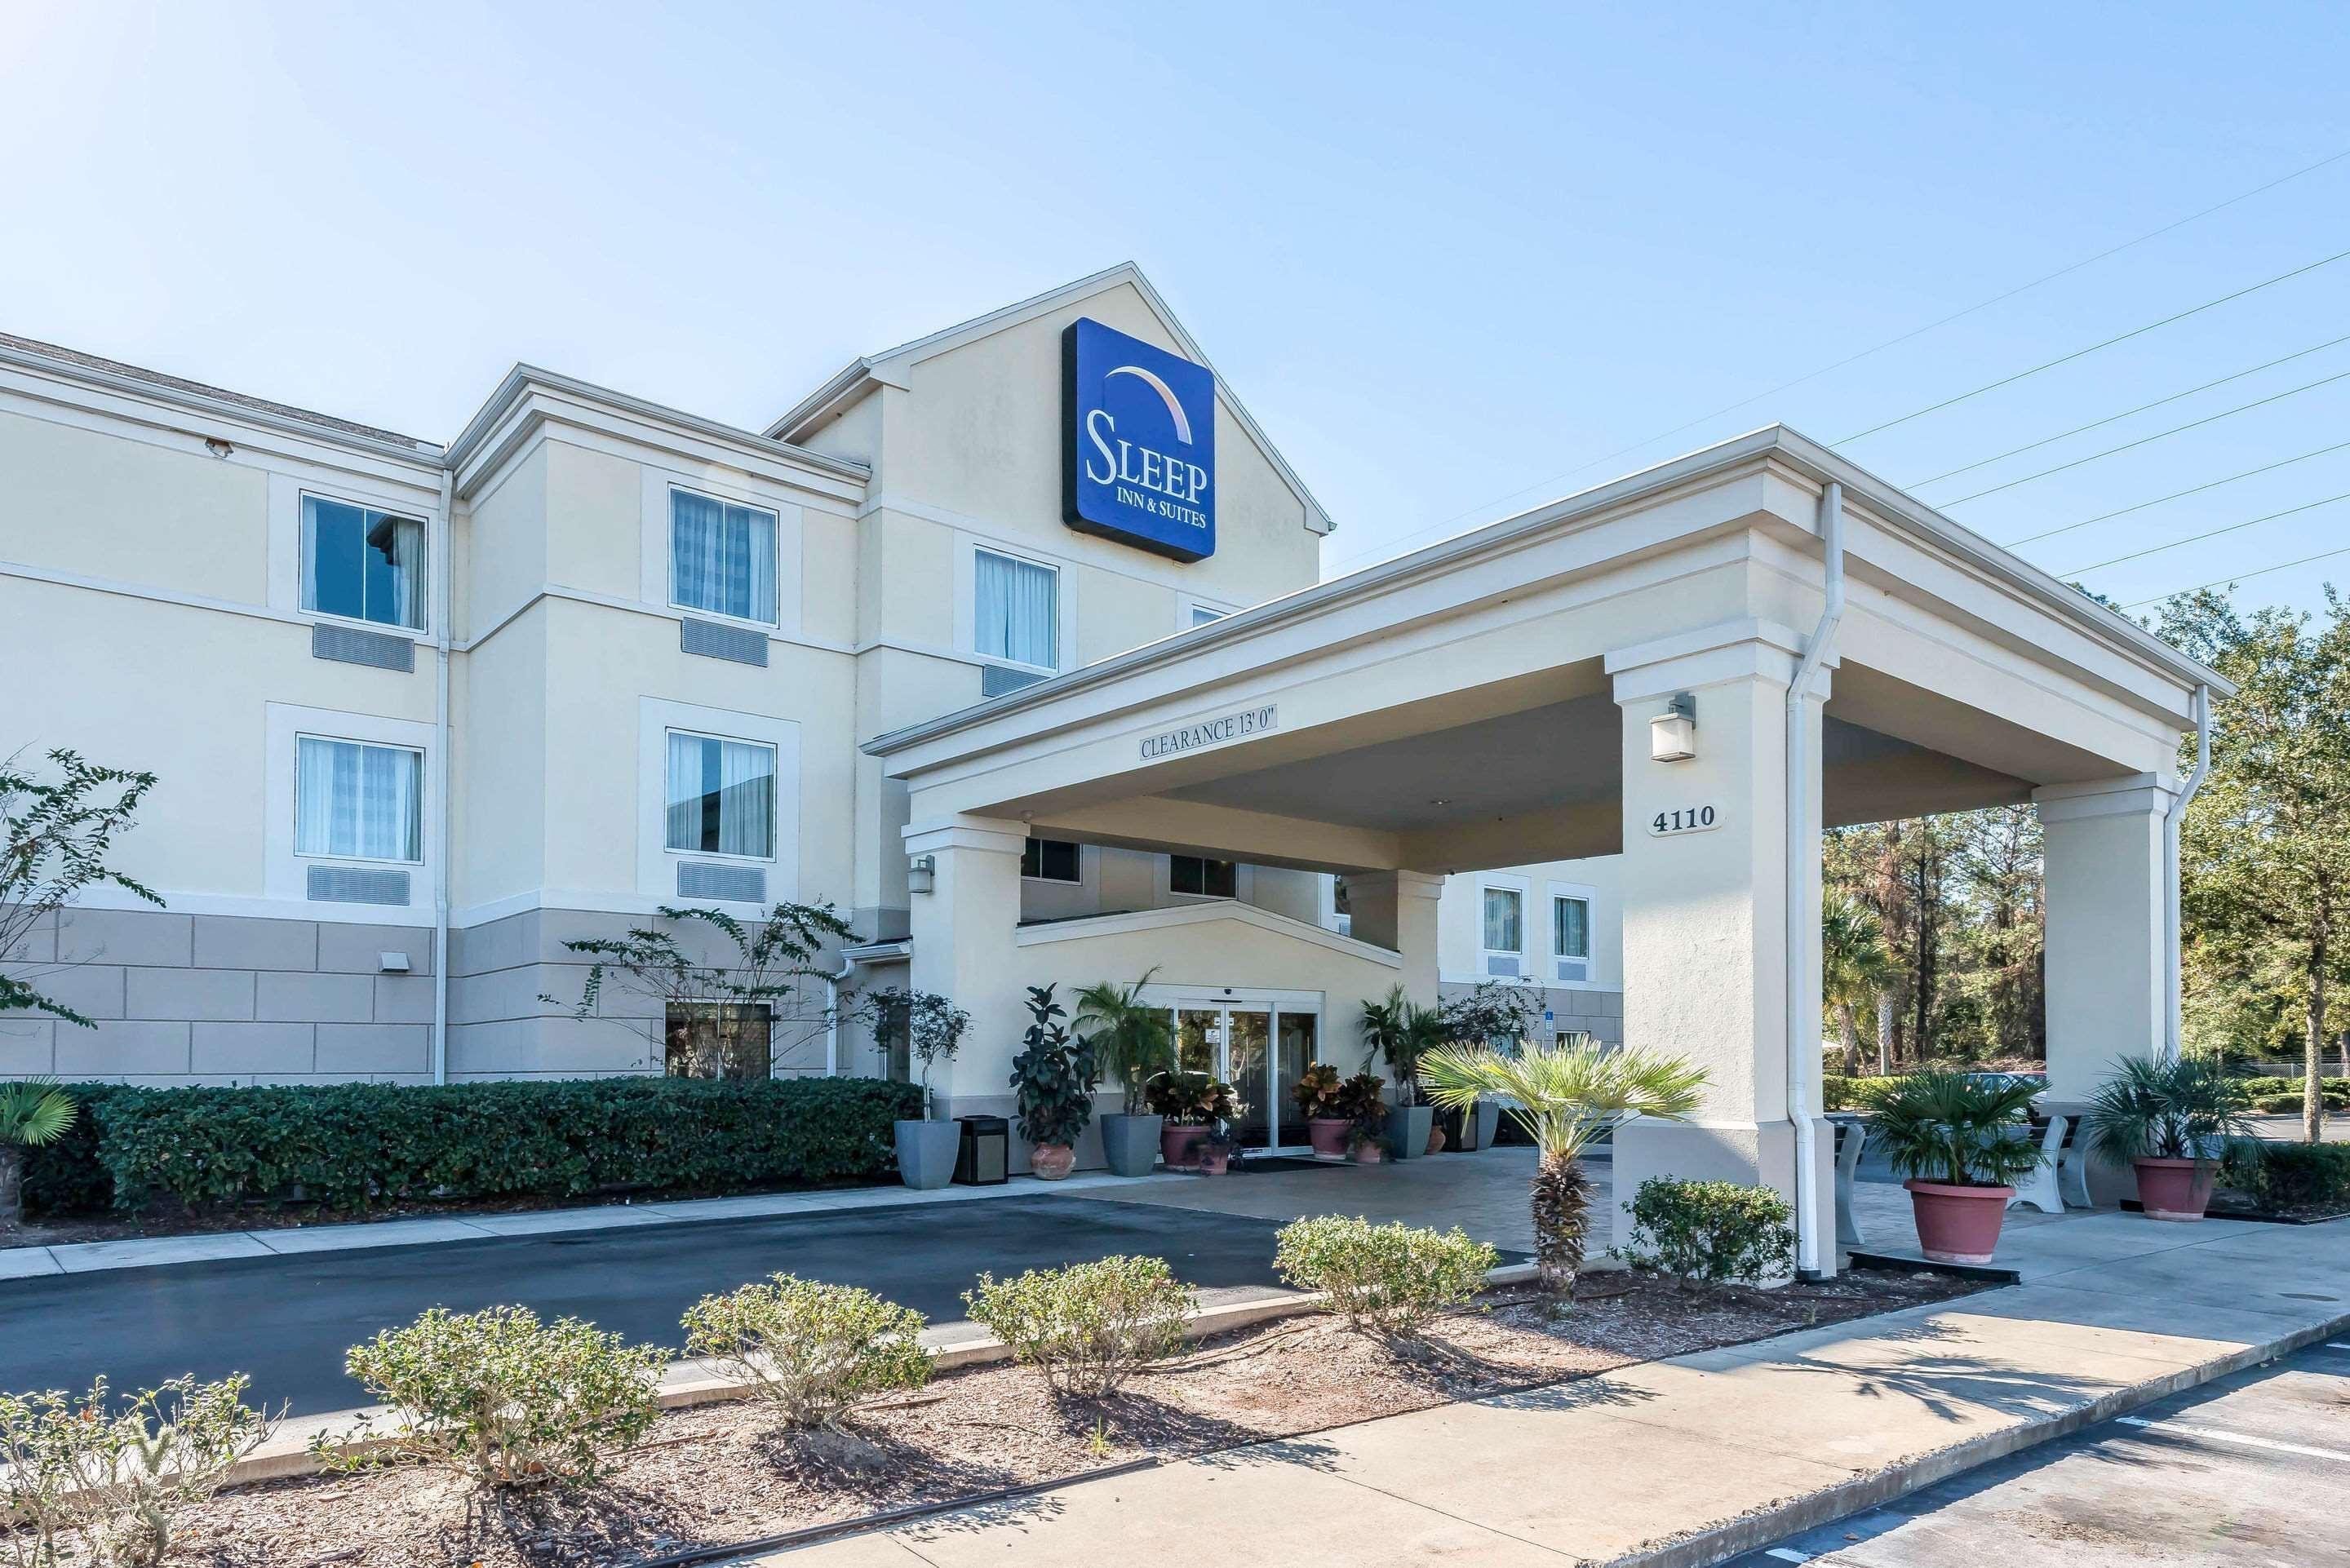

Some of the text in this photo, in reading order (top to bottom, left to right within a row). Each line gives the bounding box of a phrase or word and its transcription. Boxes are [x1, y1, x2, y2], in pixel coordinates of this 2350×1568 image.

[1086, 409, 1208, 504] SLEEP
[1116, 485, 1207, 529] INN & SUITES
[1142, 718, 1235, 759] CLEARANCE
[1239, 711, 1255, 733] 13'
[1652, 805, 1715, 832] 4110
